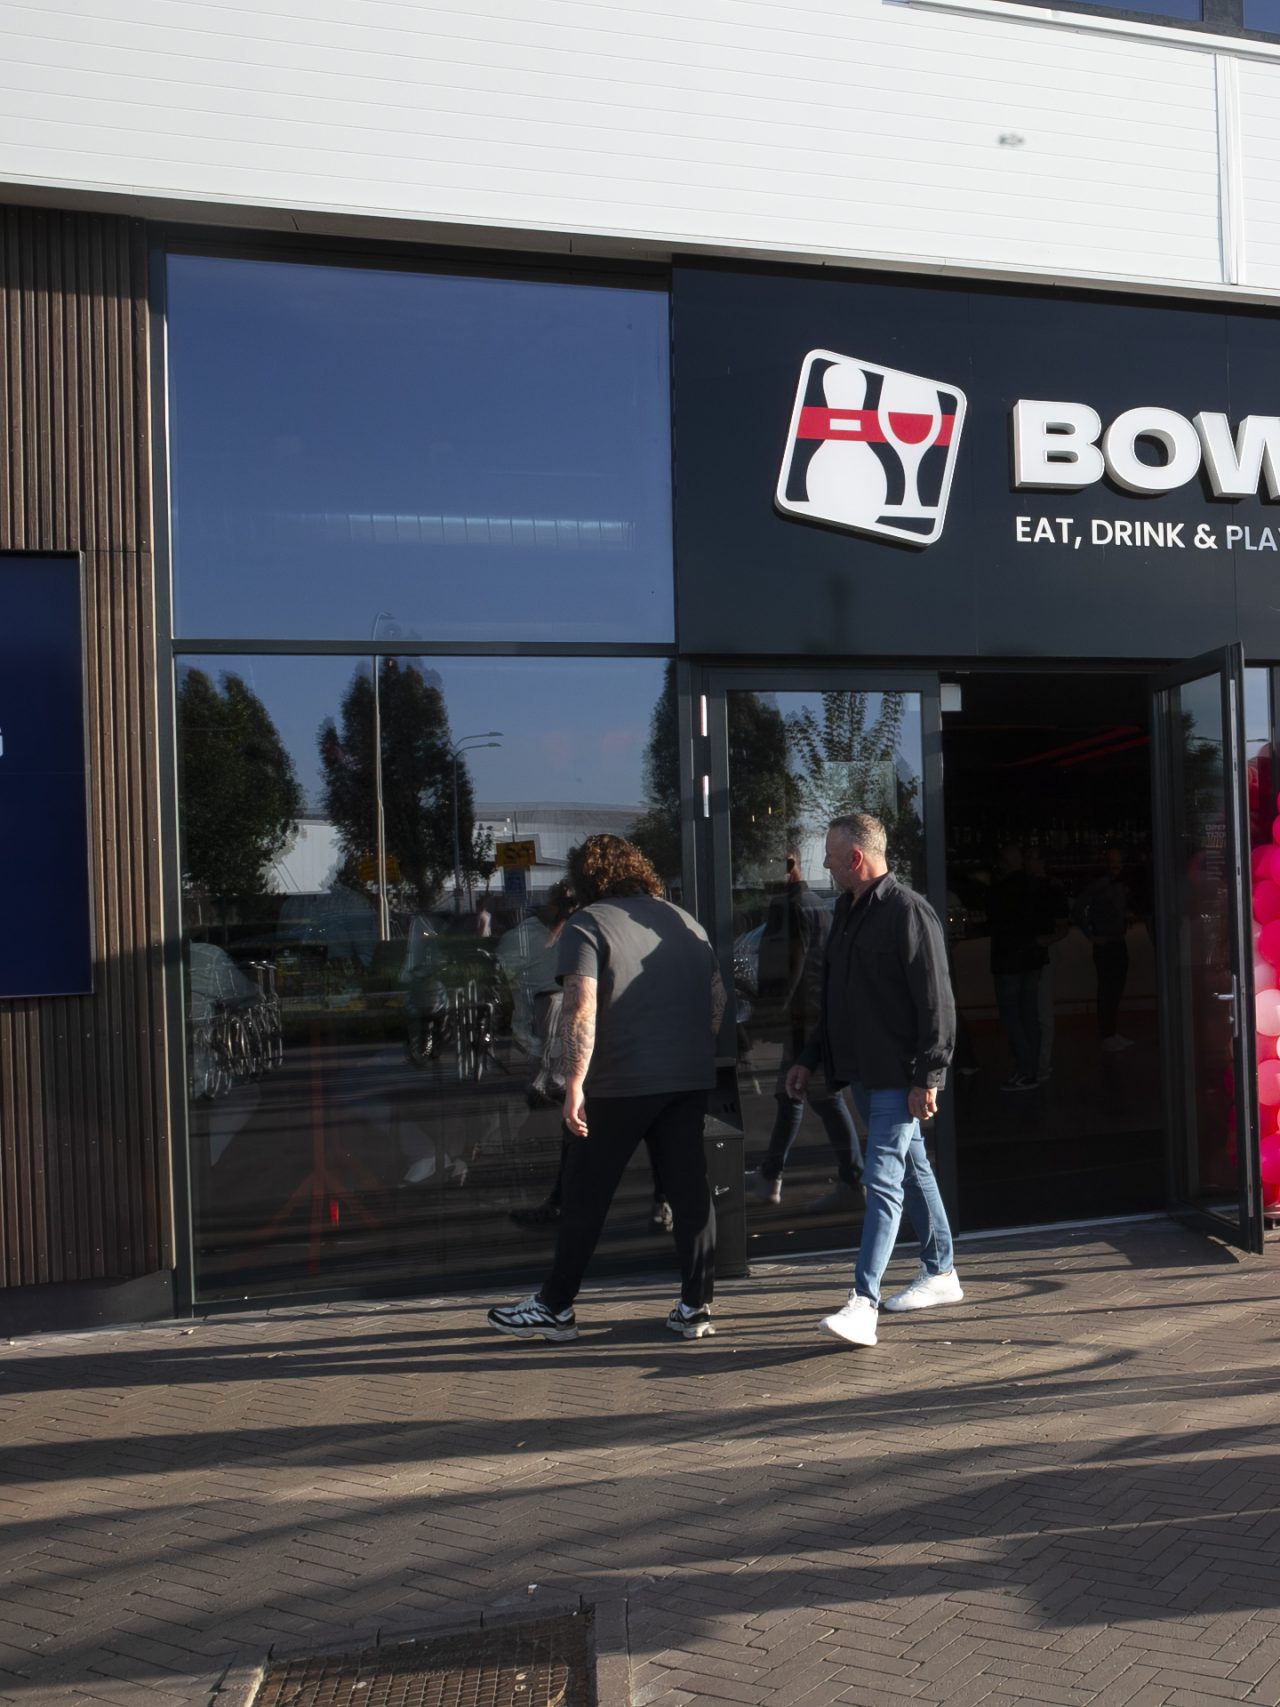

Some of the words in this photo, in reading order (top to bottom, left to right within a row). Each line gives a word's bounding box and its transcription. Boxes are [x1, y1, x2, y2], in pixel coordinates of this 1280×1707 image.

[1016, 516, 1082, 549] EAT,
[1091, 519, 1185, 549] DRINK
[1194, 523, 1218, 550] &
